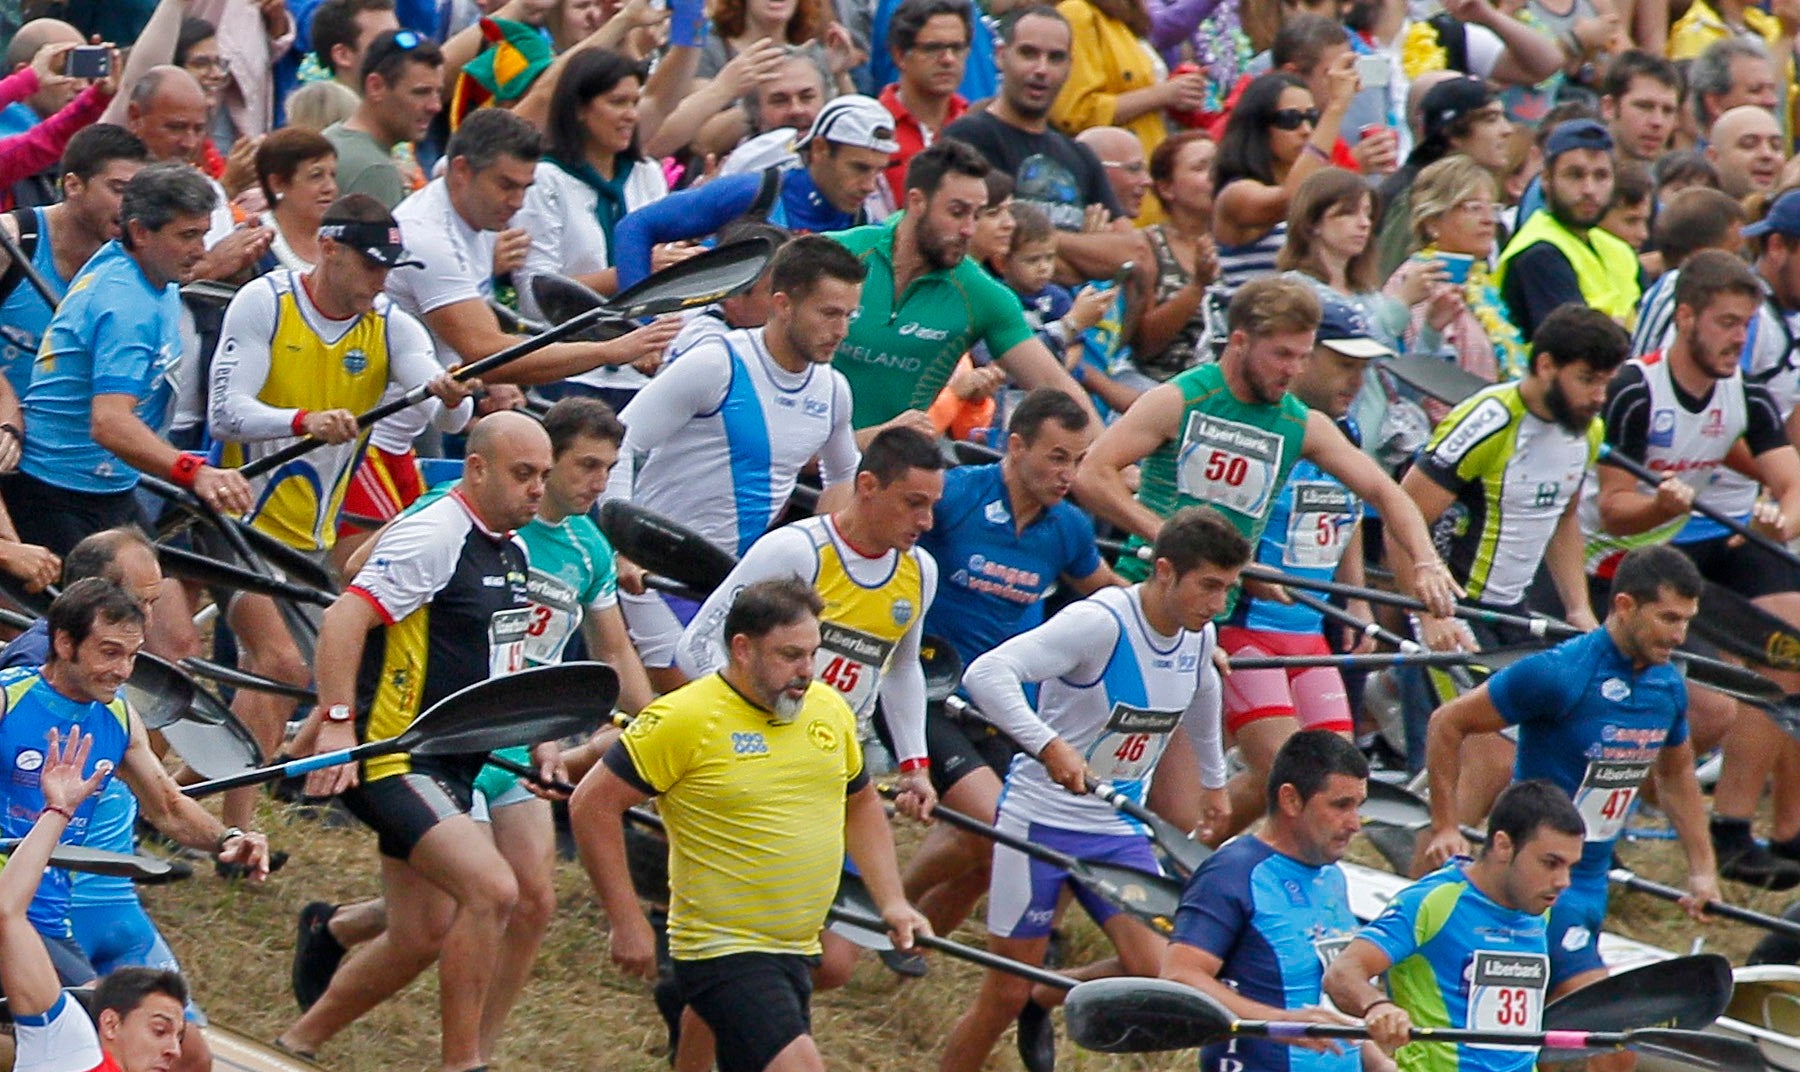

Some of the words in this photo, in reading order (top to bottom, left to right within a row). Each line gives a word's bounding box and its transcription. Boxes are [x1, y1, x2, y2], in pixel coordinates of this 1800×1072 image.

[1200, 421, 1270, 455] Liberbank
[1204, 450, 1249, 488] 50
[820, 655, 863, 694] 45
[1113, 734, 1150, 763] 46
[1601, 789, 1632, 821] 47
[1484, 960, 1543, 979] Liberbank
[1496, 988, 1528, 1027] 33
